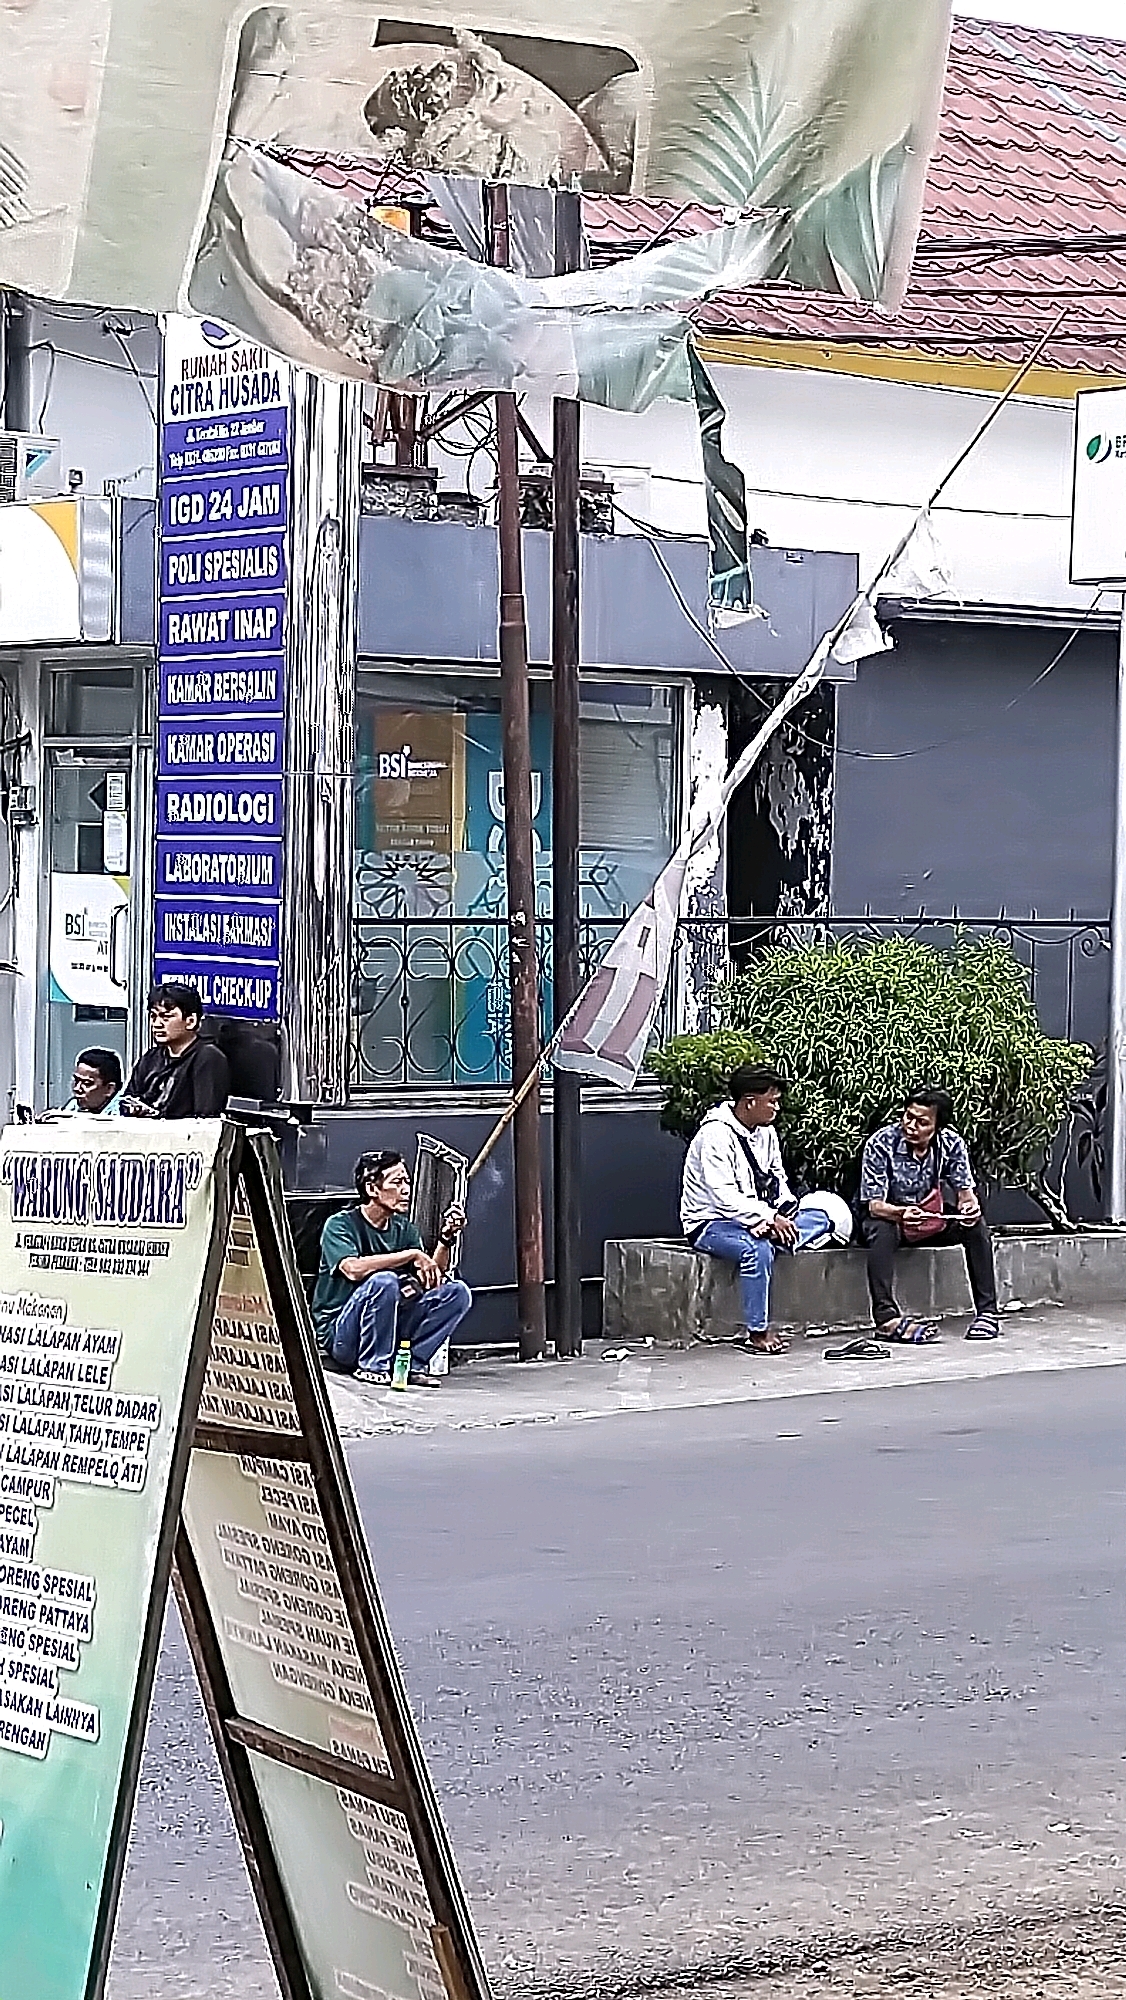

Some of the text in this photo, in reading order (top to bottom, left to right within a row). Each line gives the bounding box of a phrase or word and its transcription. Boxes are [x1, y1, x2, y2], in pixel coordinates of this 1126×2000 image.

[181, 347, 268, 381] RUMAH SAKIT
[170, 369, 281, 416] CITRA HUSADA
[170, 484, 280, 526] IGD 24 JAM
[168, 546, 278, 586] POLI SPESIALIS
[168, 607, 277, 645] RAWAT INAP
[167, 669, 277, 704] KAMAR BERSALIN
[167, 732, 276, 764] KAMAR OPERASI
[379, 750, 408, 778] BSI
[166, 792, 275, 824] RADIOLOGI
[165, 853, 274, 885] LABORATORIUM
[164, 912, 273, 947] INSTALASI FARMASI
[213, 975, 272, 1009] CHECK-UP
[27, 1327, 82, 1352] LALAPAN
[82, 1332, 117, 1355] AYAM
[21, 1356, 76, 1382] LALAPAN
[77, 1363, 109, 1385] LELE
[17, 1385, 70, 1412] LALAPAN
[74, 1393, 113, 1417] TELUR
[115, 1398, 158, 1423] DADAR
[12, 1414, 66, 1441] LALAPAN
[105, 1428, 146, 1452] TEMPE
[5, 1443, 61, 1471] LALAPAN
[62, 1452, 119, 1480] REMPELO
[120, 1461, 143, 1484] ATI
[1, 1473, 51, 1501] CAMPUR
[42, 1572, 92, 1602] SPESIAL
[39, 1603, 89, 1634] PATTAYA
[28, 1632, 76, 1663] SPESIAL
[7, 1659, 55, 1689] SPESIAL
[45, 1700, 95, 1734] LAINNYA
